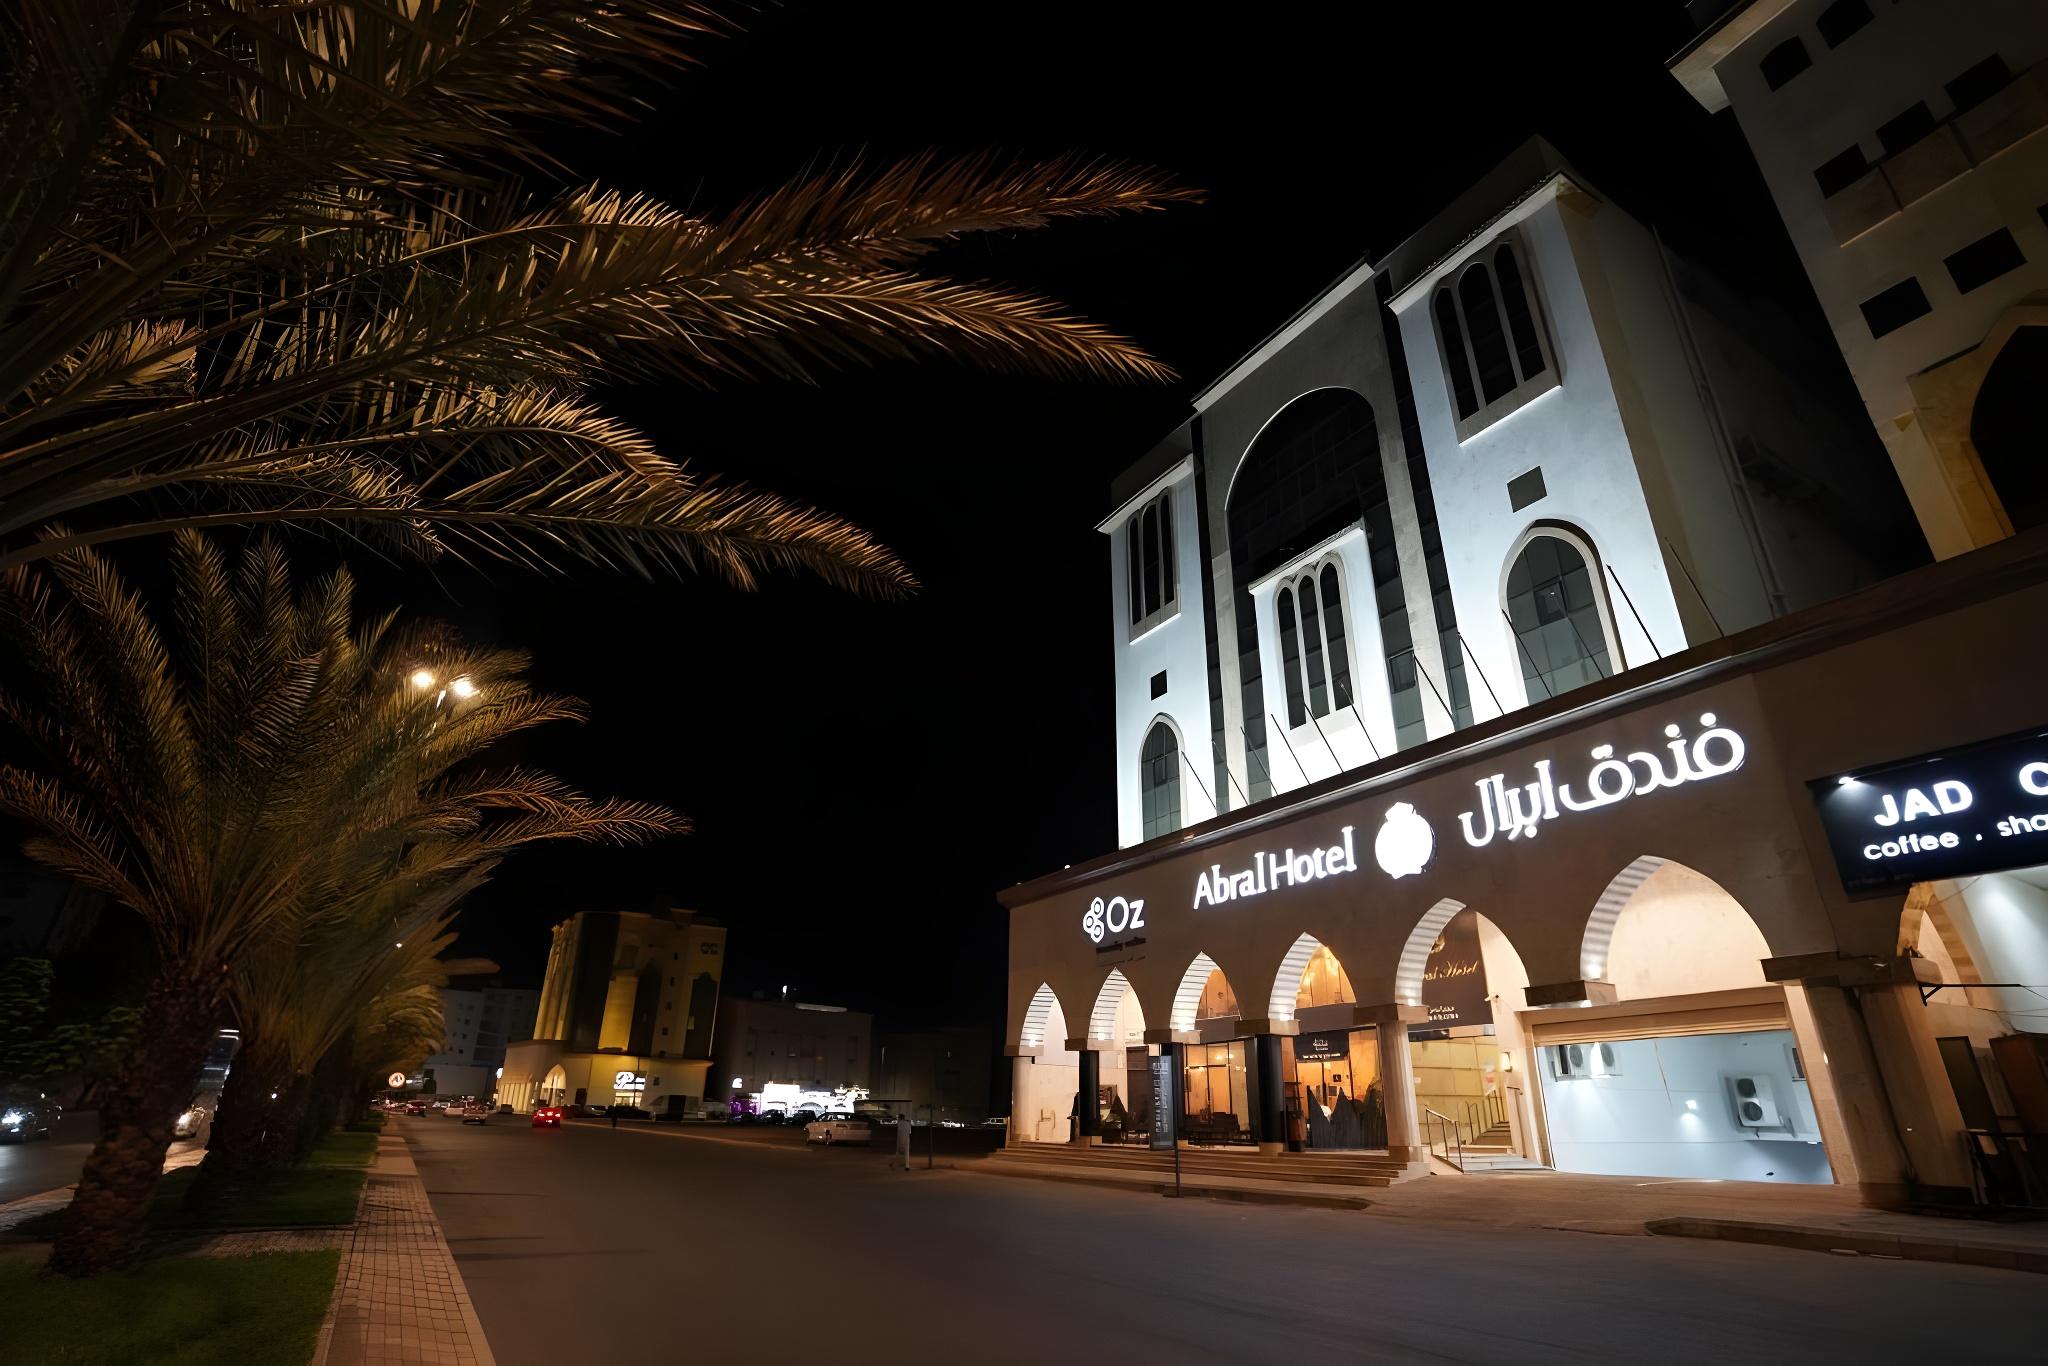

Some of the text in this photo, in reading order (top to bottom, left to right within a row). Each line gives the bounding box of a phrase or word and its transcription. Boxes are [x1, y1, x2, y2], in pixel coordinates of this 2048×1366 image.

[1558, 711, 1746, 812] فندق
[1873, 780, 1974, 828] JAD
[1193, 825, 1358, 910] Abral Hotel
[1863, 831, 1960, 860] coffee
